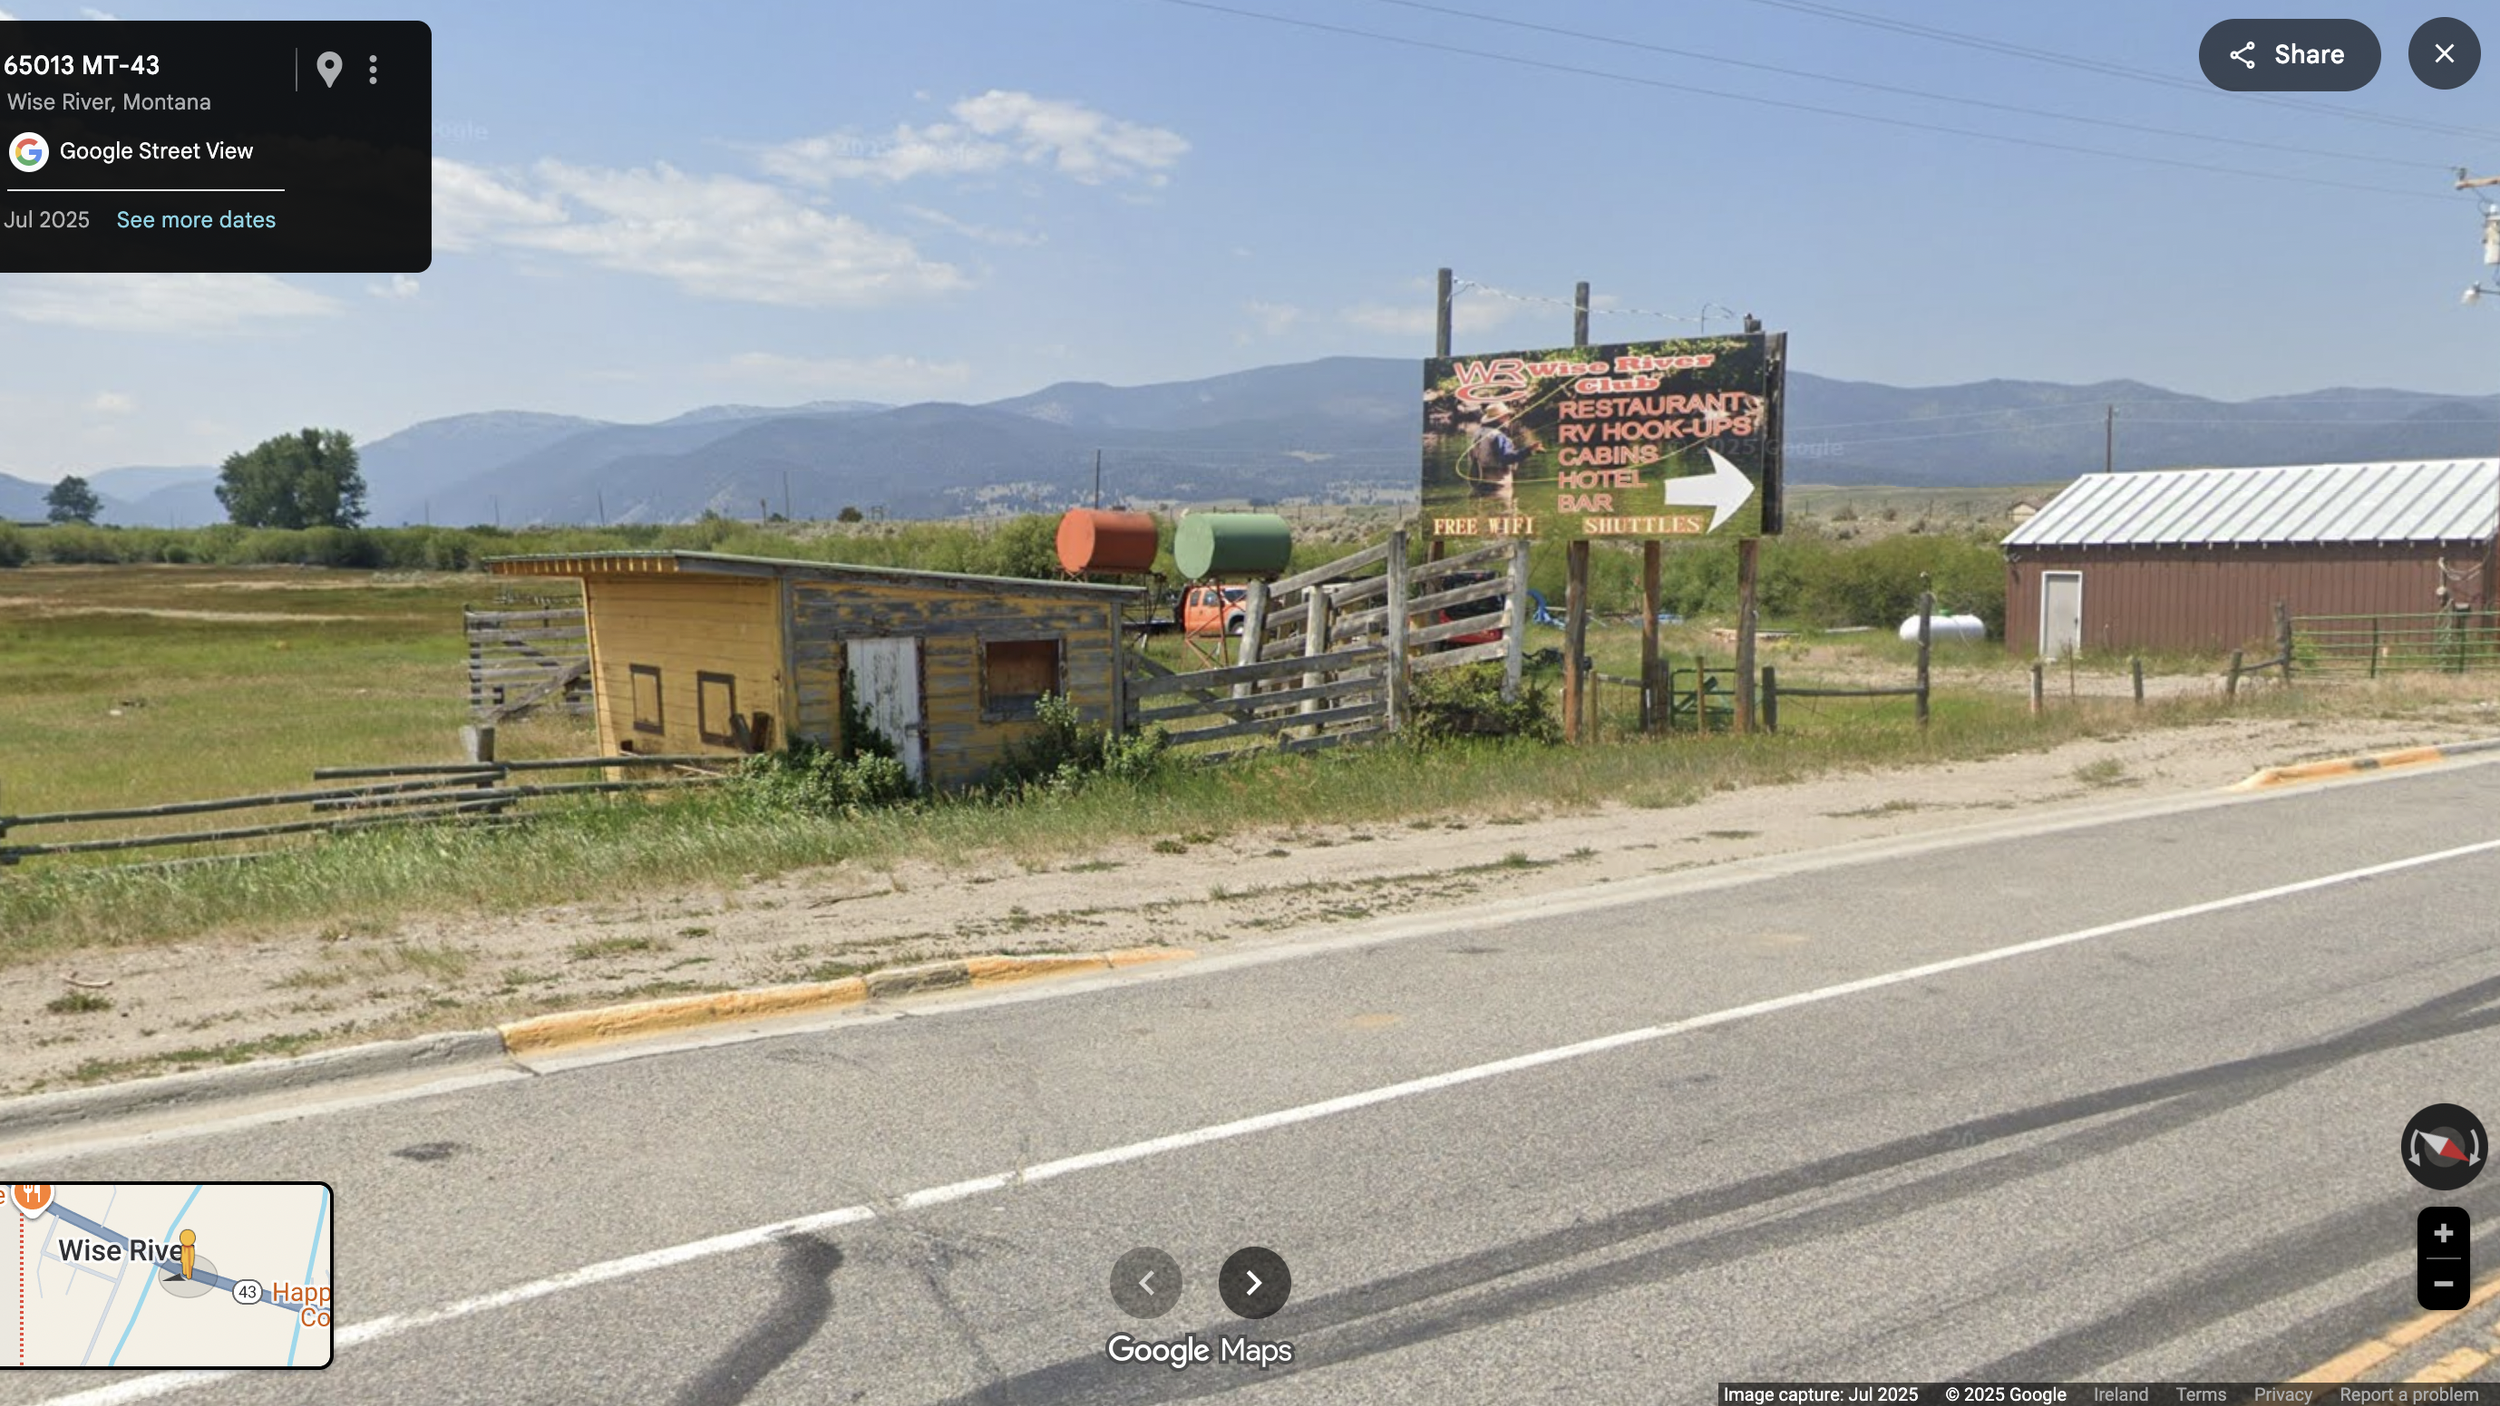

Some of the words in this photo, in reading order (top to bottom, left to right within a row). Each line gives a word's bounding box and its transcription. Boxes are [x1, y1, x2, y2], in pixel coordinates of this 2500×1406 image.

[1527, 360, 1610, 379] Wise
[1614, 353, 1716, 373] River
[1575, 376, 1661, 395] Club
[1558, 392, 1746, 420] RESTAURANT
[1558, 423, 1597, 444] RV
[1602, 416, 1753, 442] HOOK-UPS
[1558, 445, 1660, 466] CABINS
[1558, 470, 1649, 490] HOTEL
[1558, 493, 1614, 513] BAR
[1433, 518, 1478, 536] FREE
[1488, 516, 1535, 535] WIFI
[1584, 516, 1702, 535] SHUTTLES
